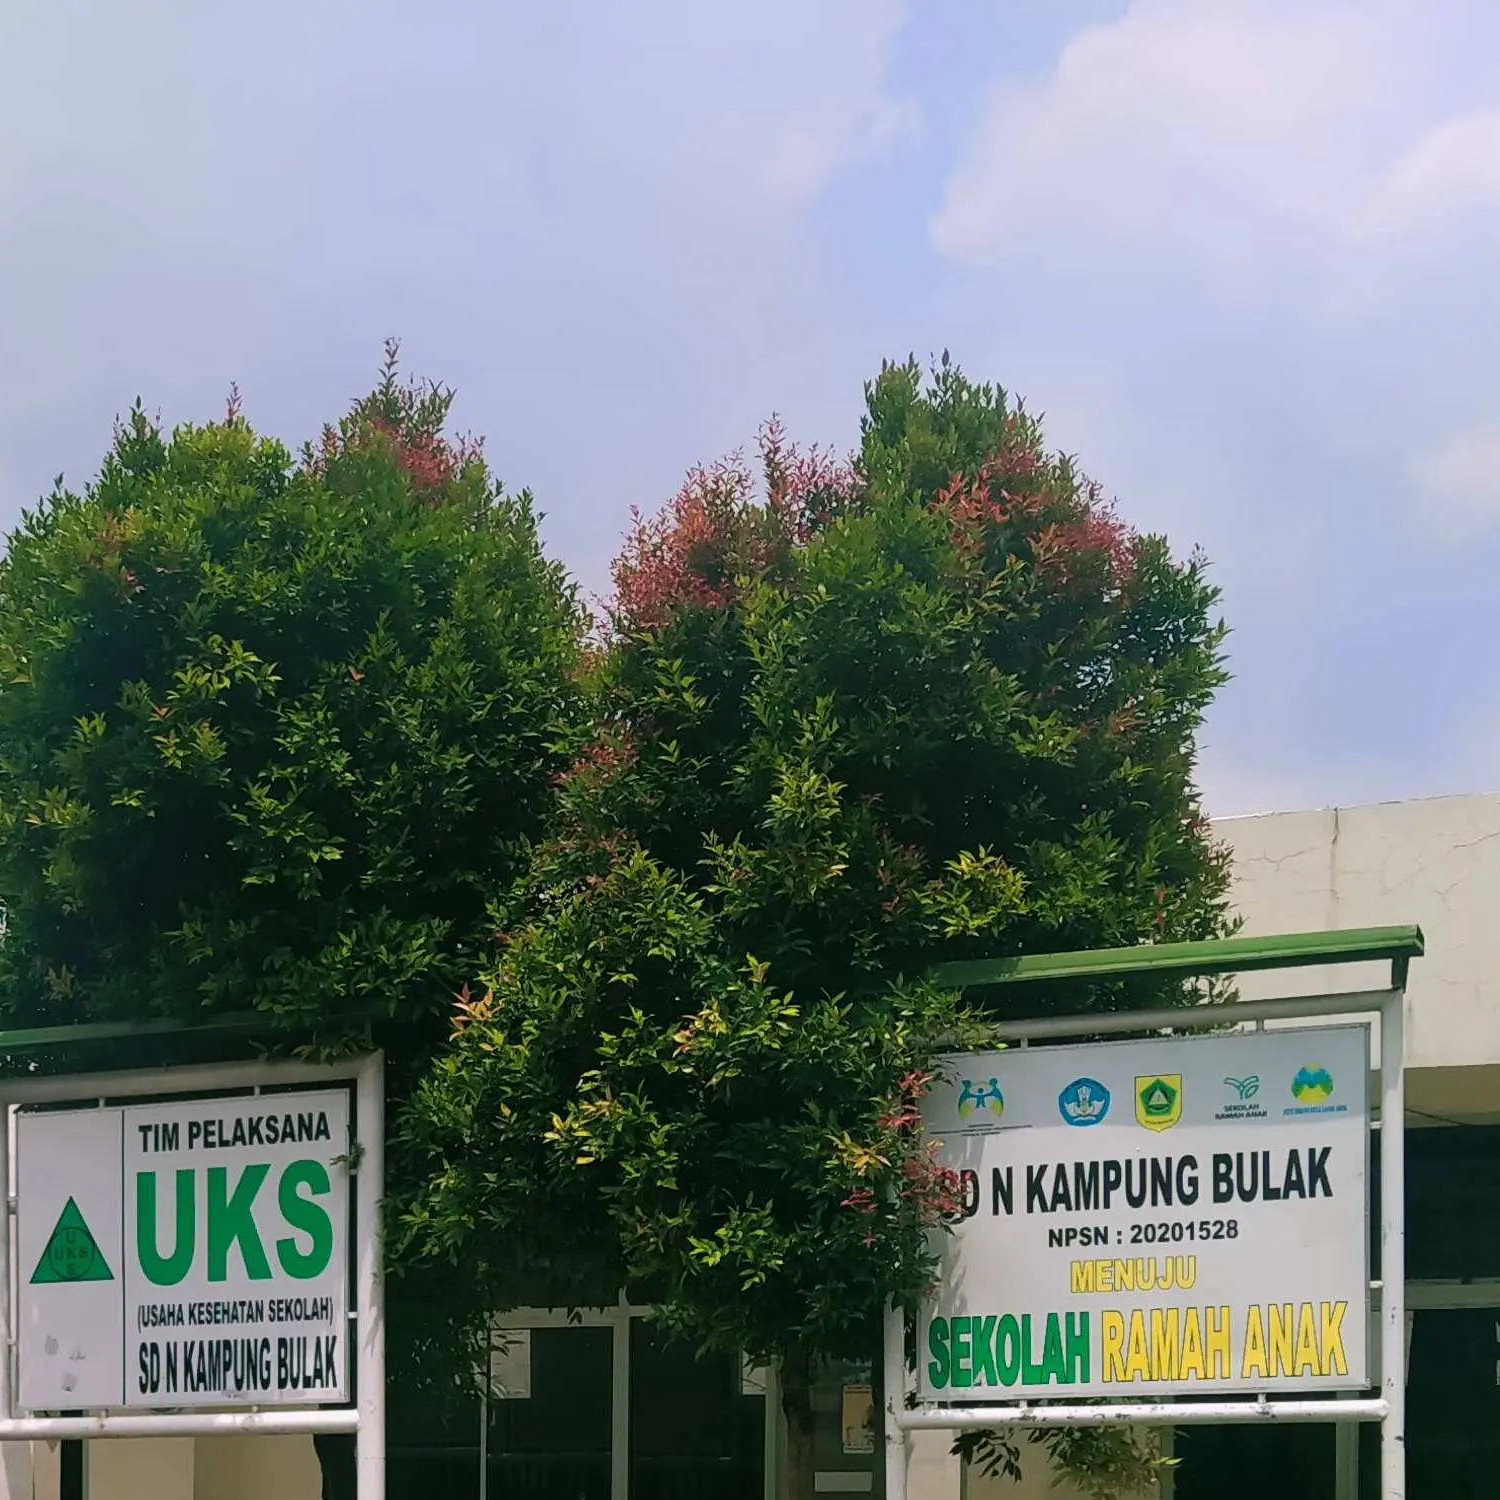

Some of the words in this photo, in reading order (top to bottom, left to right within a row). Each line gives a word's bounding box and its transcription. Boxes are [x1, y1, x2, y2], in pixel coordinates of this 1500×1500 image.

[139, 1123, 180, 1152] TIM
[189, 1112, 331, 1149] PELAKSANA
[992, 1166, 1013, 1216] N
[1026, 1155, 1199, 1214] KAMPUNG
[1212, 1146, 1333, 1203] BULAK
[136, 1159, 333, 1286] UKS
[1048, 1226, 1109, 1247] NPSN
[1130, 1219, 1239, 1244] 20201528
[1070, 1256, 1197, 1293] MENUJU
[137, 1304, 184, 1333] (USAHA
[188, 1300, 264, 1325] KESEHATAN
[268, 1297, 334, 1326] SEKOLAH)
[139, 1342, 160, 1394] SD
[166, 1341, 178, 1393] N
[183, 1337, 271, 1393] KAMPUNG
[277, 1335, 338, 1390] BULAK
[928, 1312, 1090, 1388] SEKOLAH
[1101, 1306, 1230, 1383] RAMAH
[1241, 1301, 1348, 1378] ANAK
